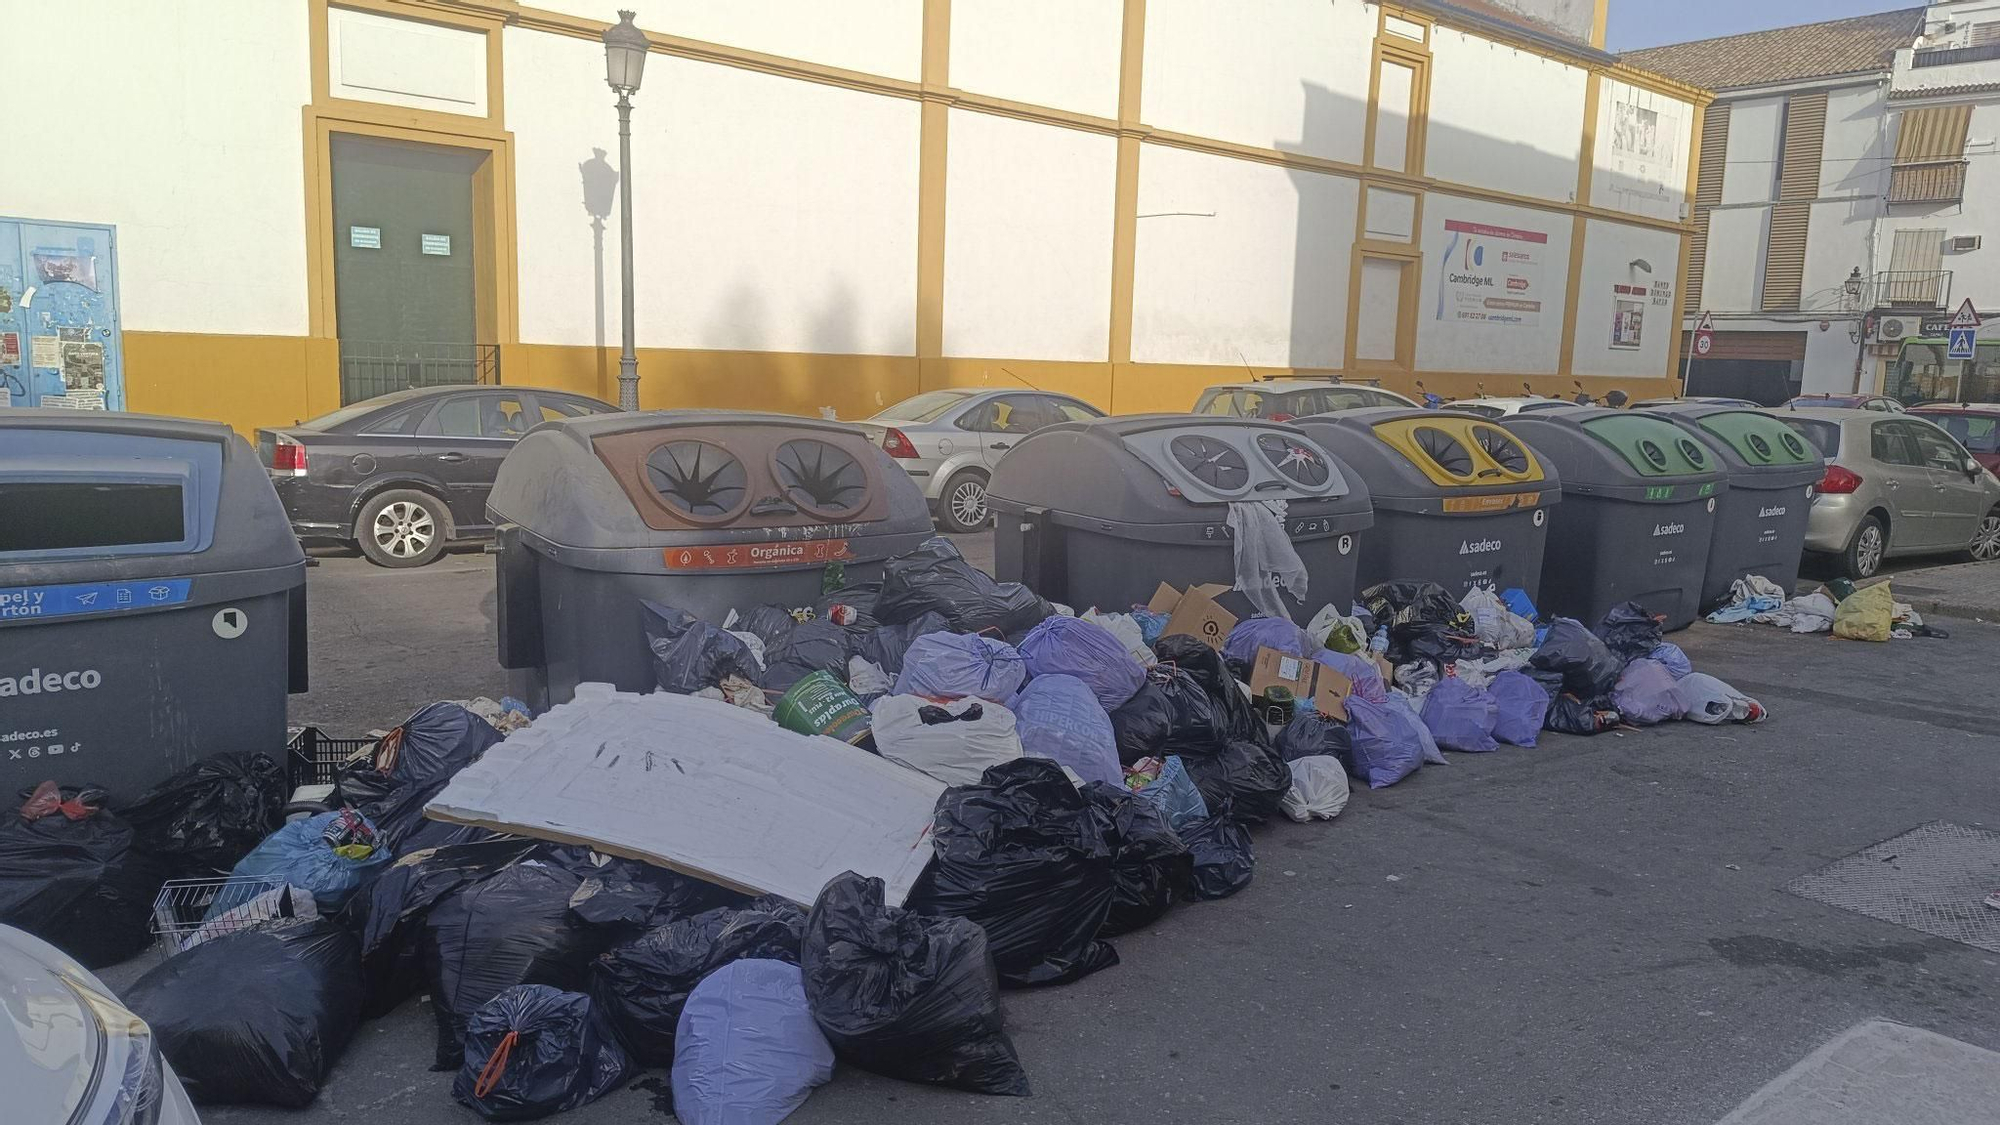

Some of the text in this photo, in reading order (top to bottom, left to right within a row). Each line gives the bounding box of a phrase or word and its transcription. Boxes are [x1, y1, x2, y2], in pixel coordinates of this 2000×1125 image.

[1449, 273, 1494, 287] Cambridge ML
[1700, 340, 1708, 348] 30
[1765, 506, 1786, 517] sadeco
[1660, 522, 1685, 535] sadeco
[1342, 537, 1349, 549] R
[1469, 538, 1501, 554] sadeco
[750, 544, 803, 560] Orgánica
[34, 592, 44, 604] y
[2, 602, 42, 617] rtón
[0, 668, 101, 697] adeco
[813, 698, 860, 727] Duraplás
[0, 728, 59, 743] adeco.es
